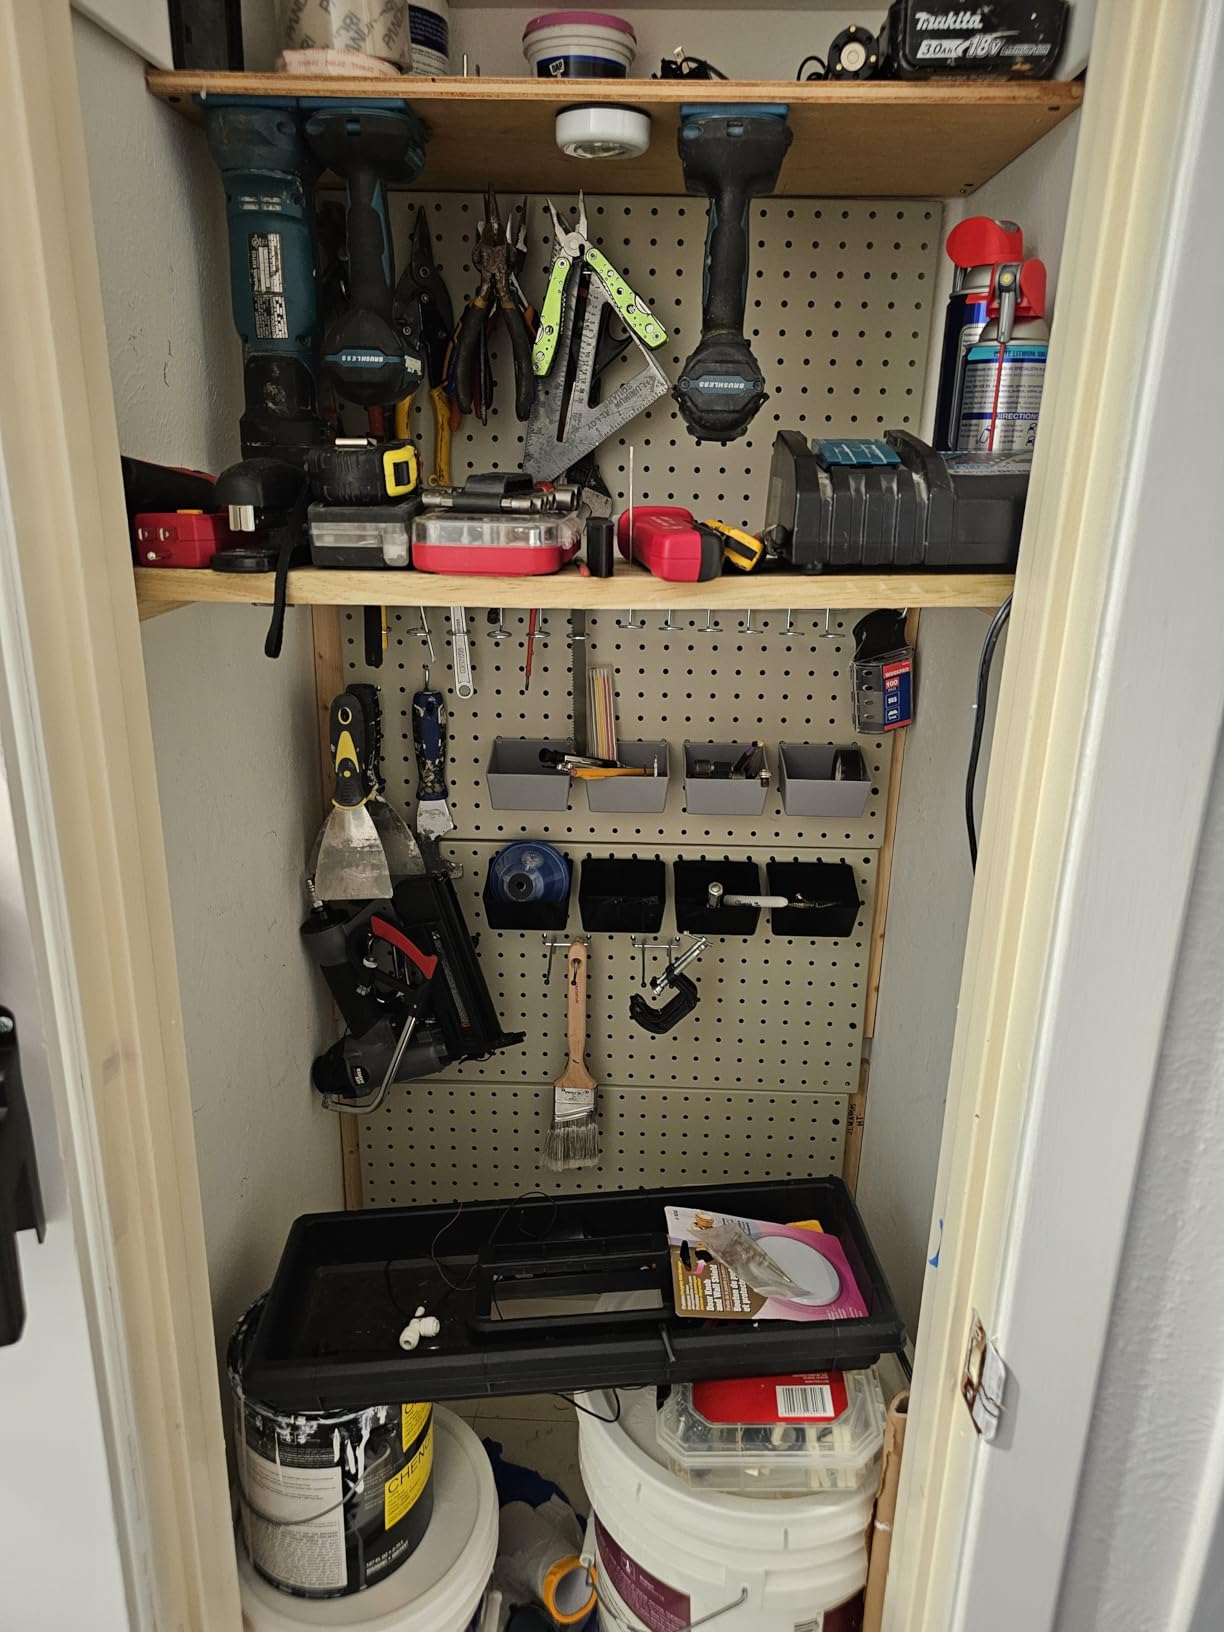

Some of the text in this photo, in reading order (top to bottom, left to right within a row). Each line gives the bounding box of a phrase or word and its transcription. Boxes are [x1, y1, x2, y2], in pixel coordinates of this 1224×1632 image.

[914, 11, 983, 31] Makita
[551, 61, 563, 75] DAP
[698, 381, 745, 389] BRUSHLESS
[884, 667, 910, 677] WORKPRO
[886, 680, 898, 688] 100
[703, 1279, 714, 1311] Door Knob
[710, 1264, 723, 1312] and Wall Shield
[732, 1289, 742, 1312] Bouton
[742, 1304, 750, 1312] et
